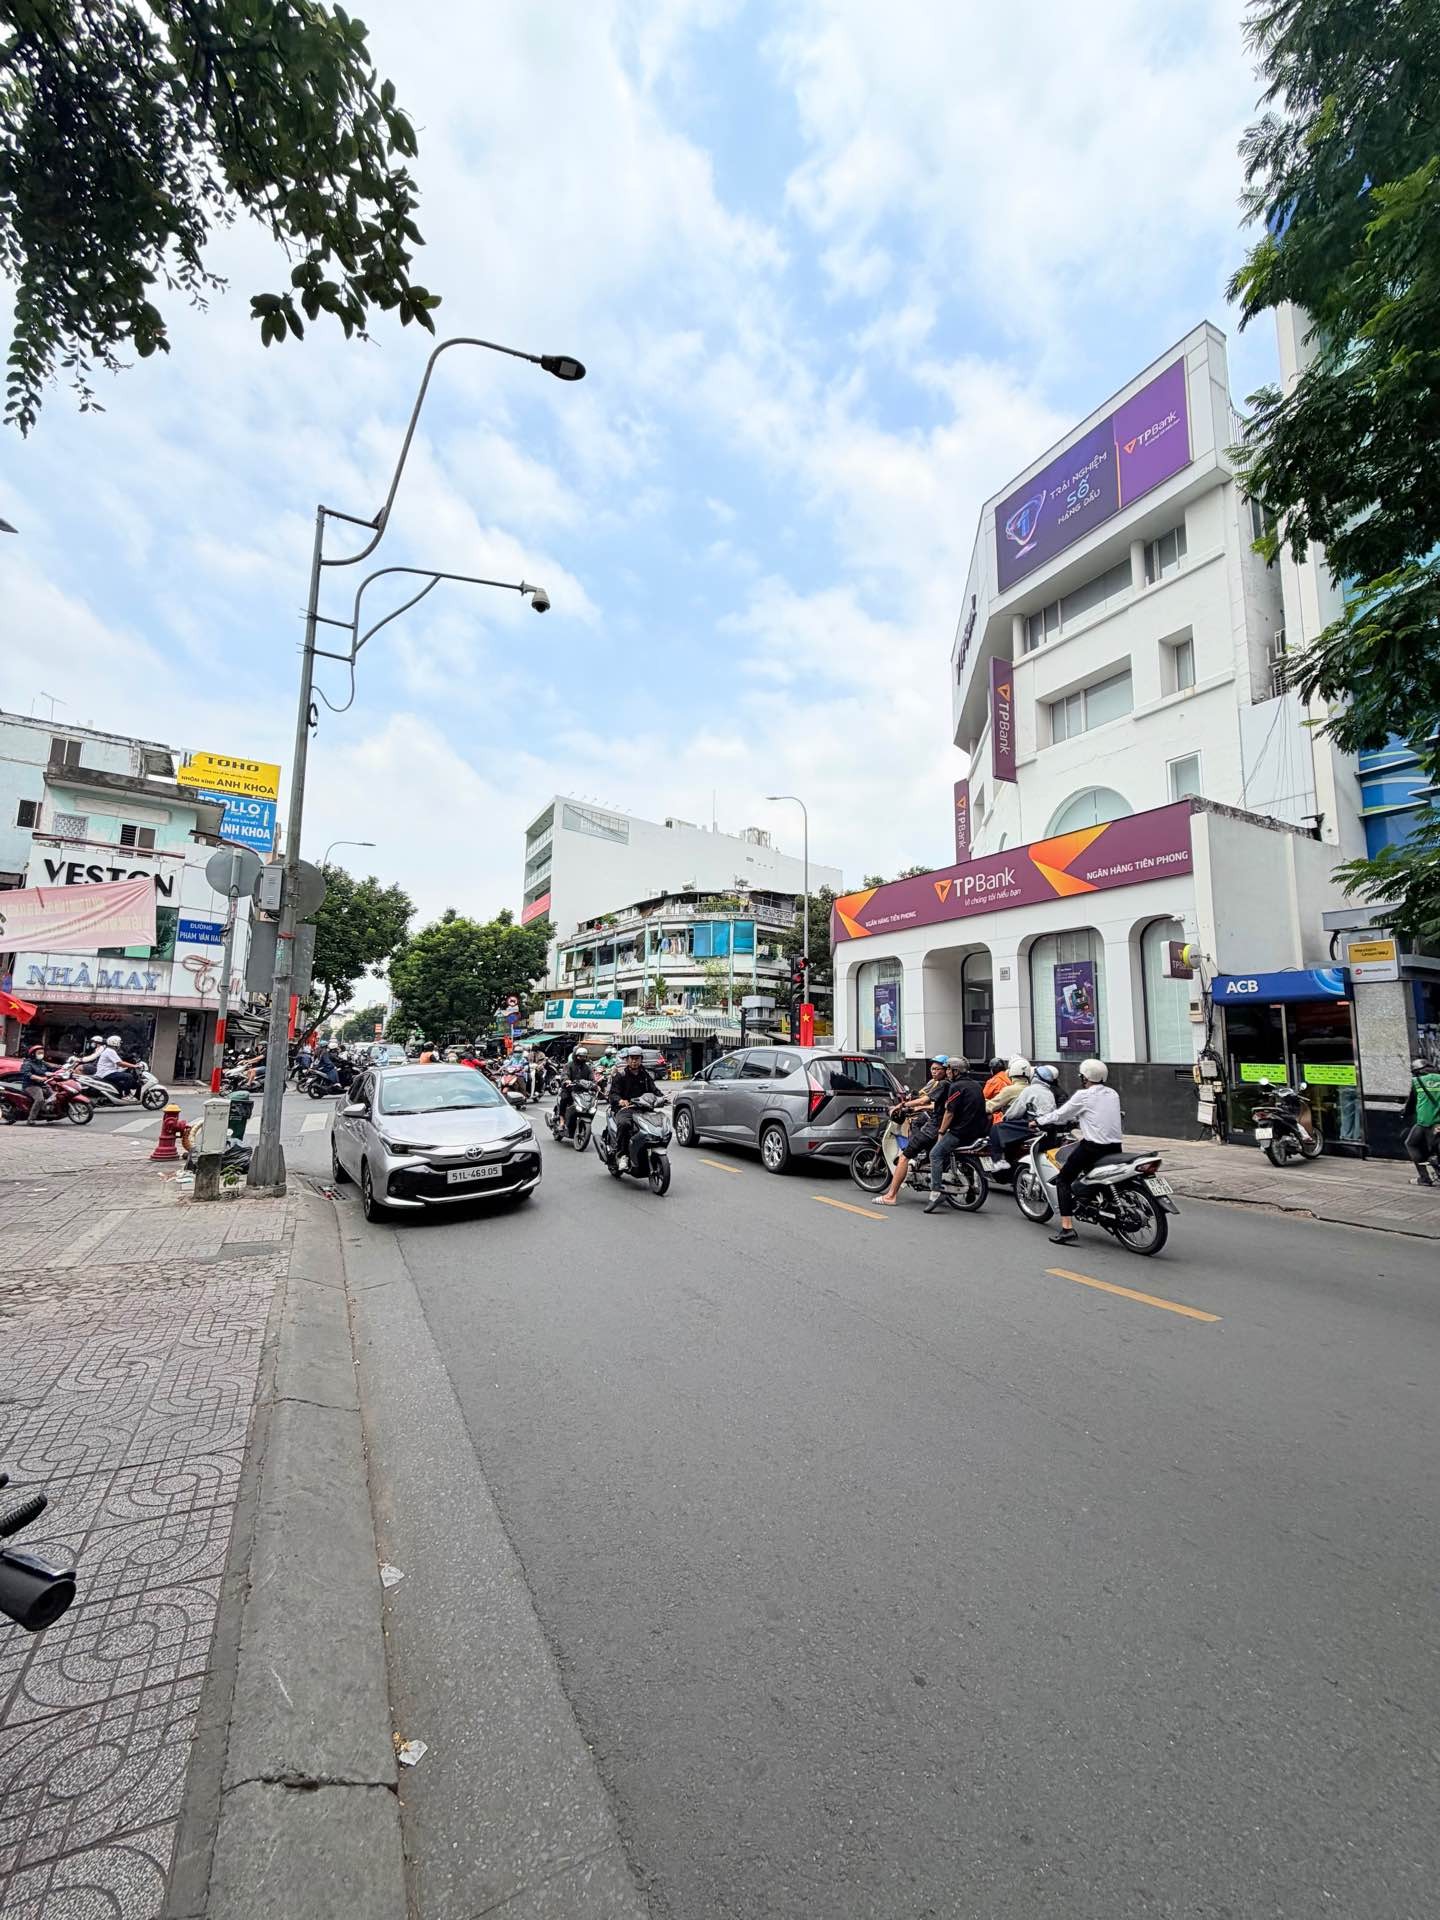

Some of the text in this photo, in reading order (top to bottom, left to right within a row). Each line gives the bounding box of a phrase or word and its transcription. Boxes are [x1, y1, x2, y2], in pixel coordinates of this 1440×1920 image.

[1137, 410, 1176, 445] TPBank
[1067, 473, 1089, 509] SỐ
[998, 702, 1011, 755] TPBank
[206, 757, 260, 772] TOHO
[216, 778, 240, 789] ANH
[243, 782, 275, 795] KHOA
[241, 824, 271, 839] KHOA
[958, 810, 967, 849] TPBank
[1086, 850, 1189, 880] NGÂN HÀNG TIÊN PHONG
[953, 866, 1016, 897] TPBank
[26, 962, 162, 991] NHÀ MAY
[1226, 979, 1259, 994] ACB
